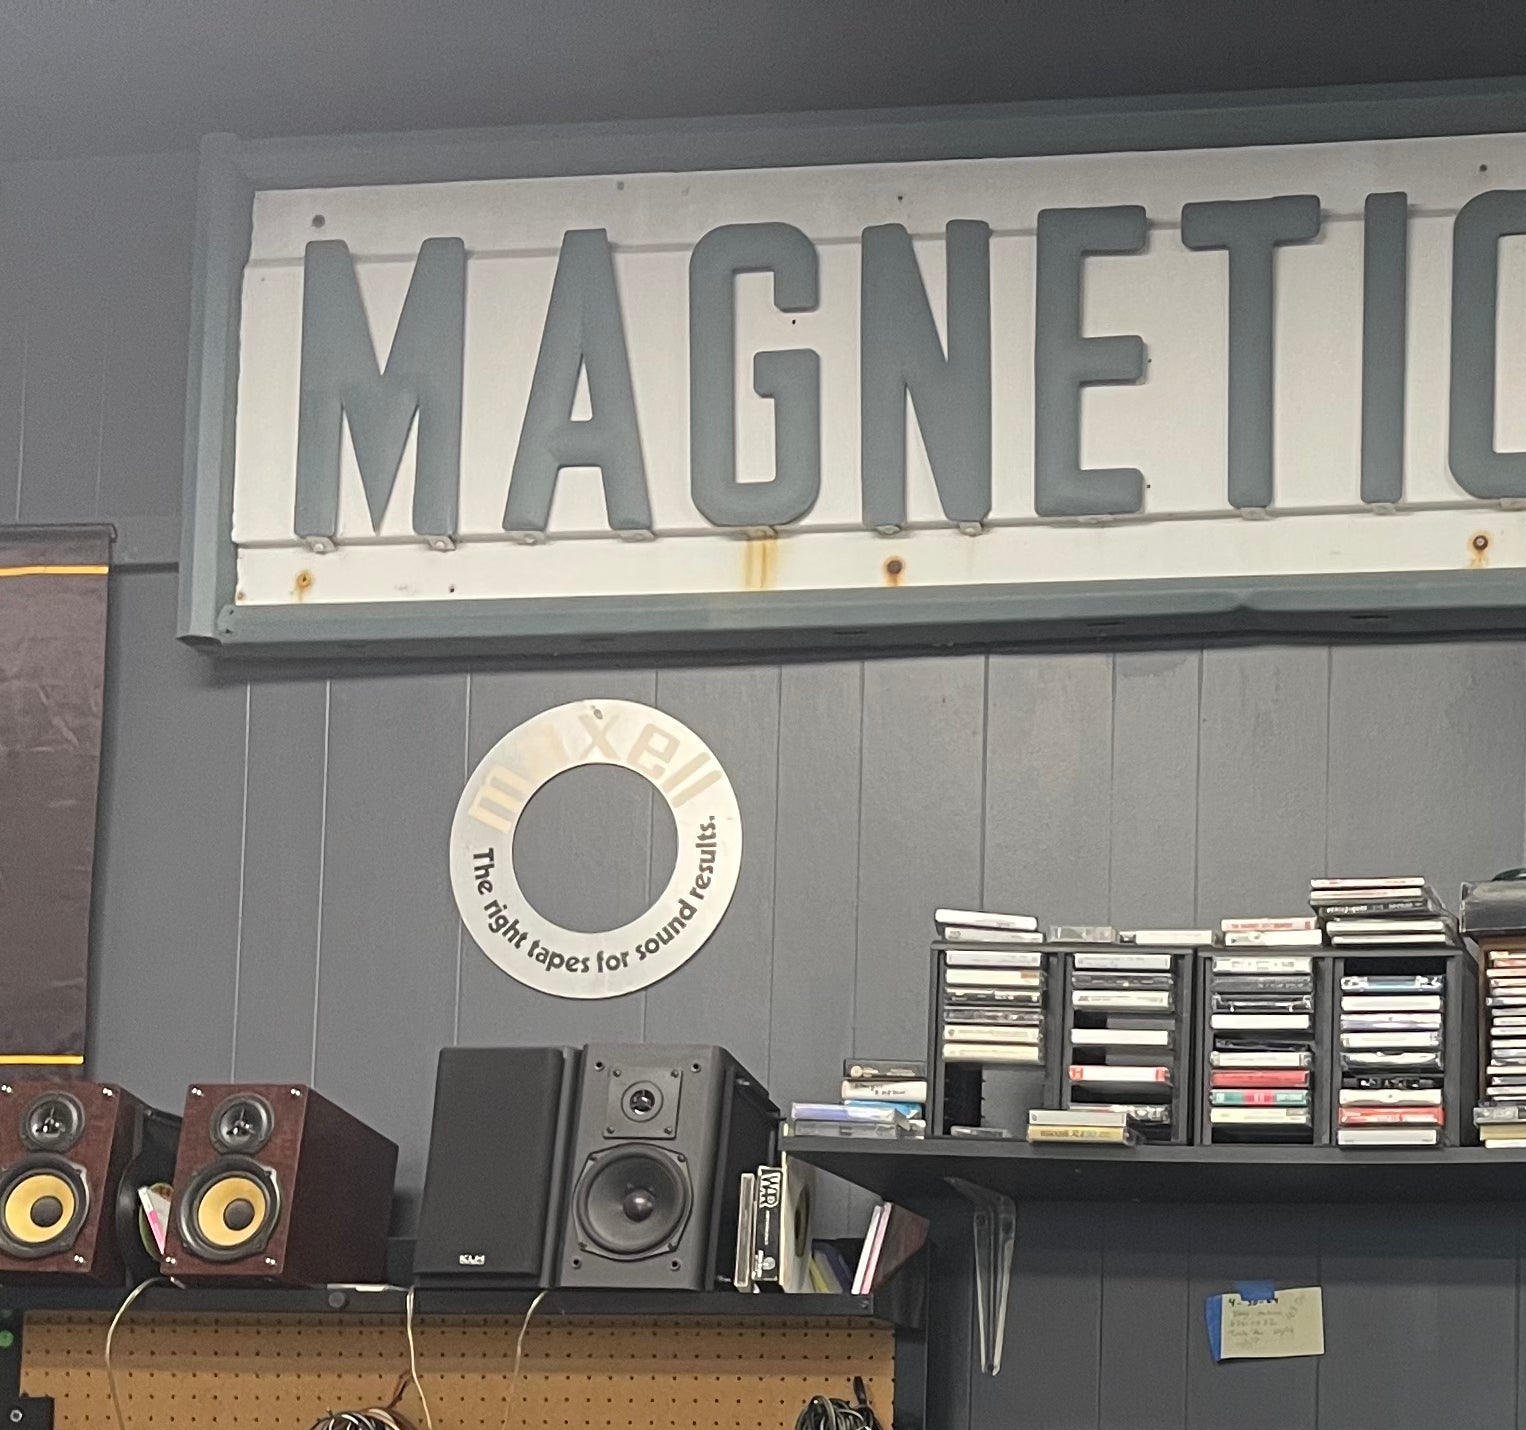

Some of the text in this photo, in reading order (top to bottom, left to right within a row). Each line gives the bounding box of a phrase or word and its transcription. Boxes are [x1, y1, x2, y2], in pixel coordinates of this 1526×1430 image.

[473, 815, 717, 973] The right tapes for sound results.
